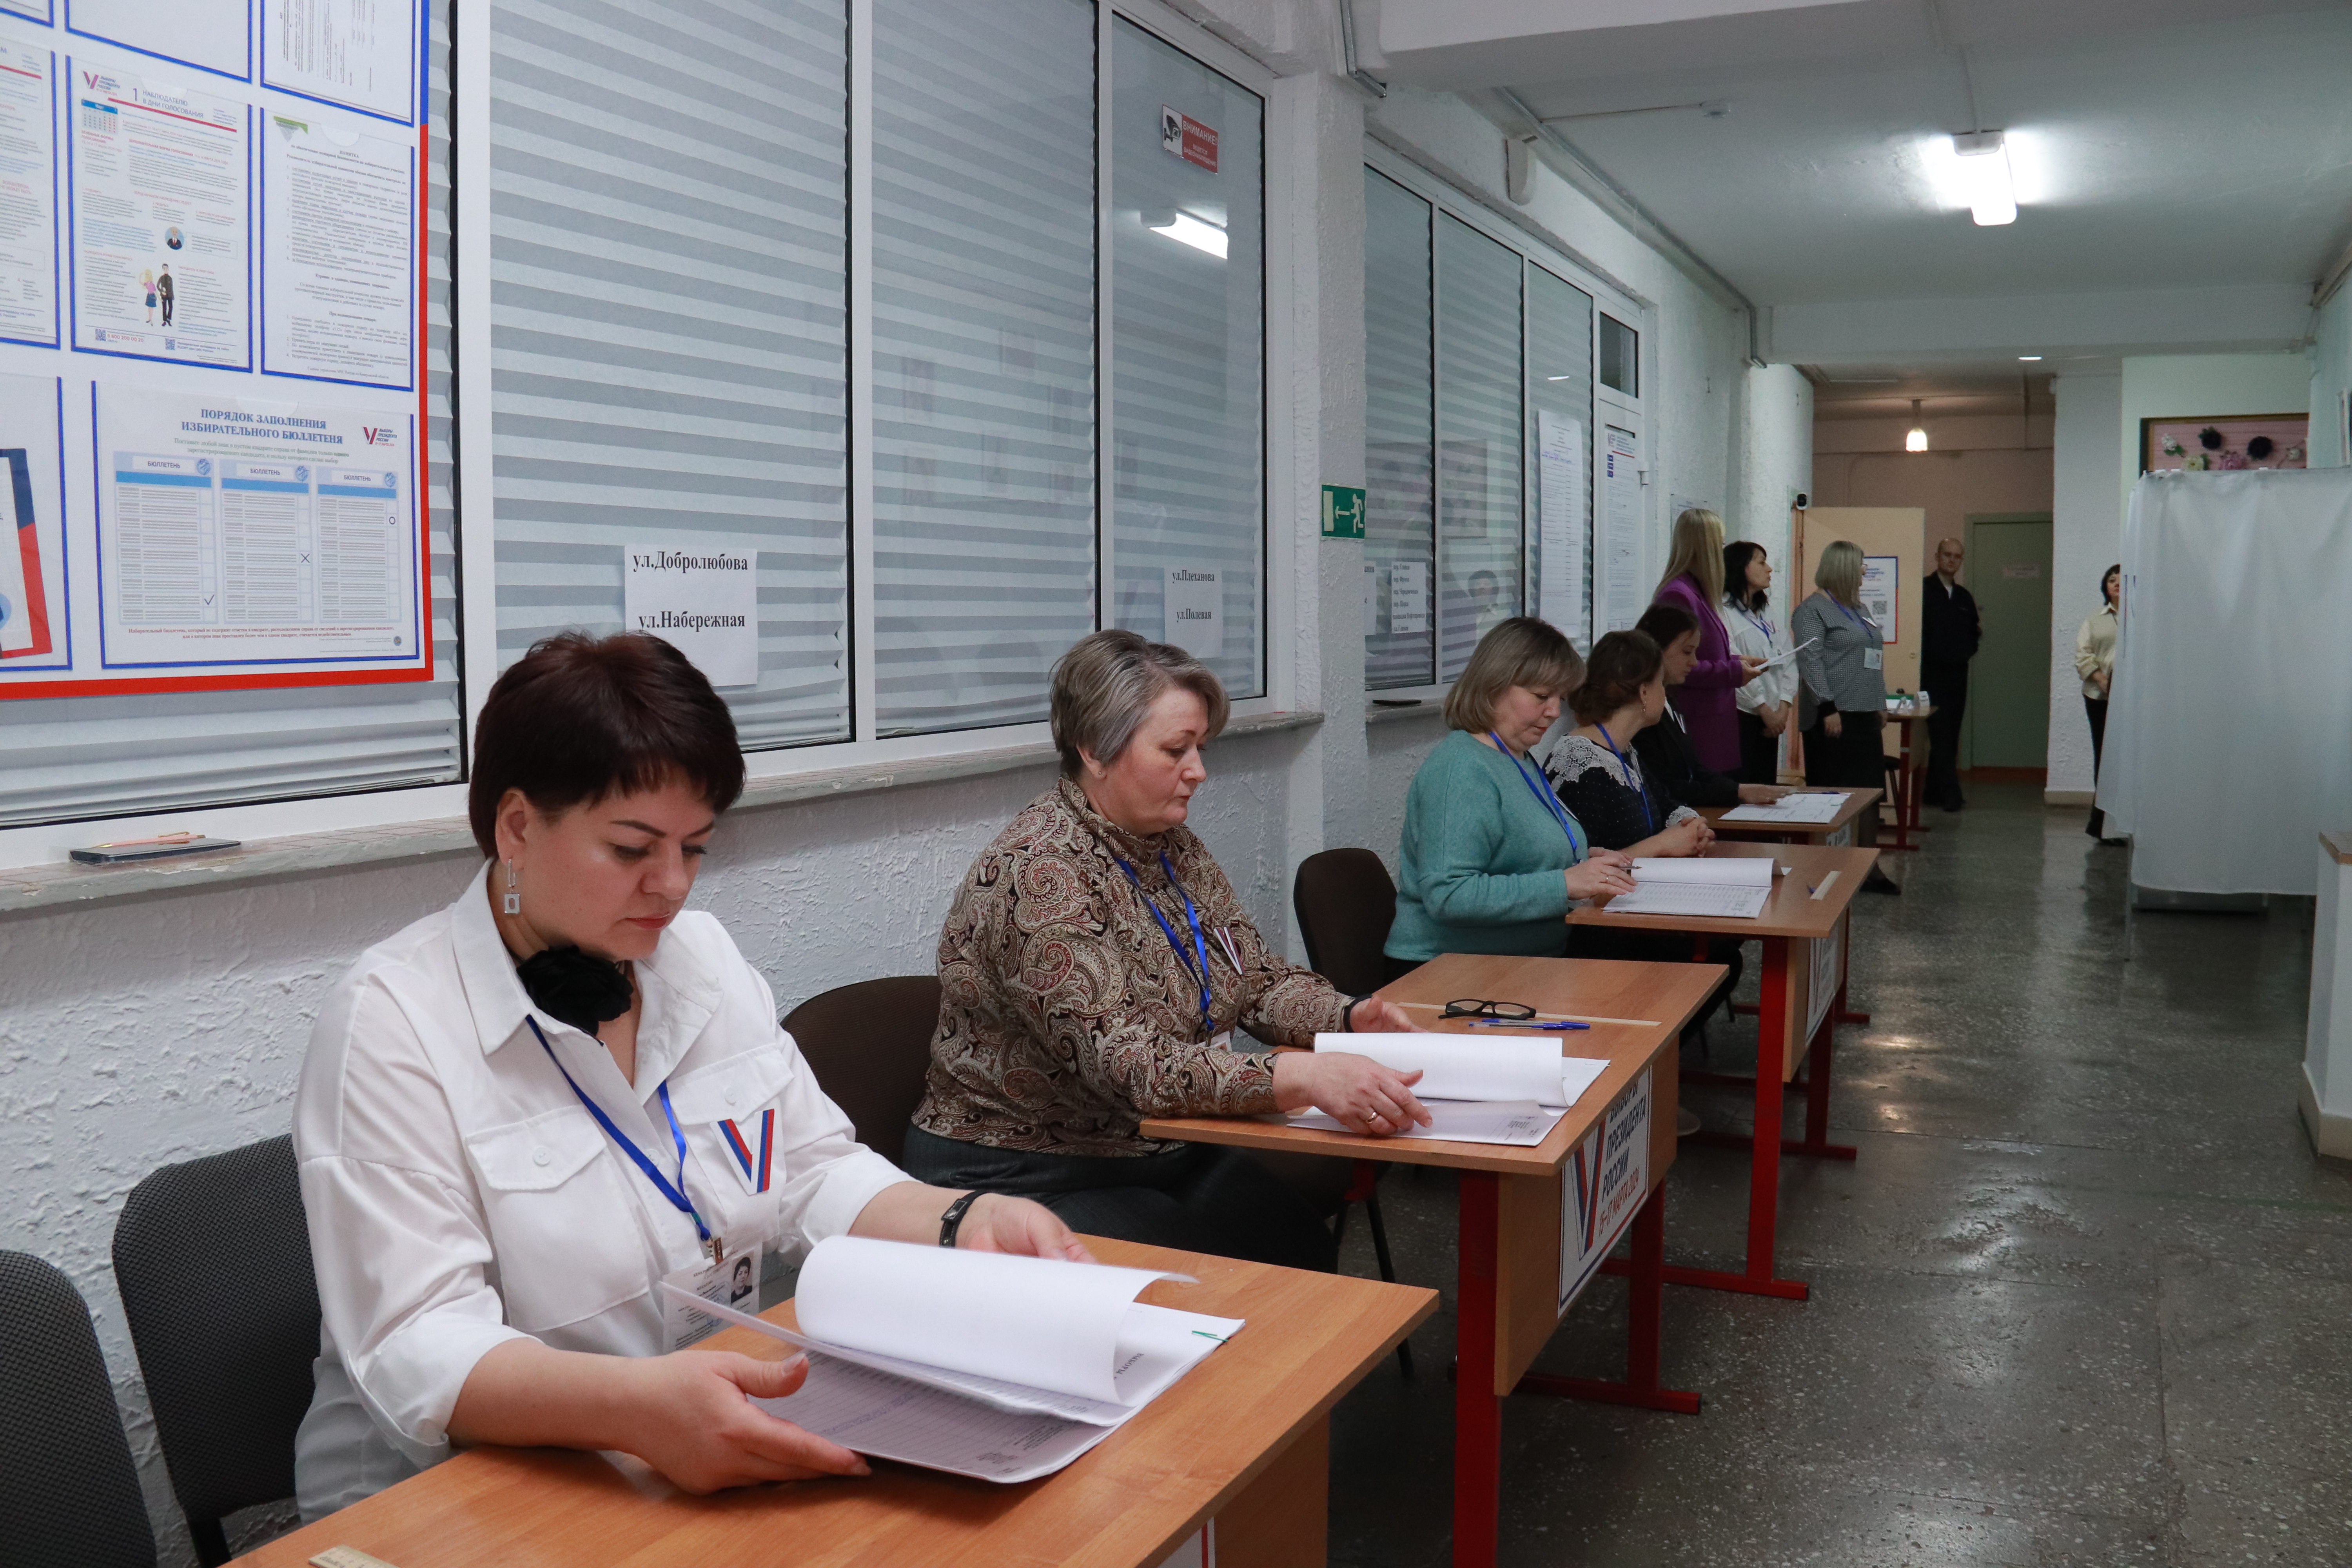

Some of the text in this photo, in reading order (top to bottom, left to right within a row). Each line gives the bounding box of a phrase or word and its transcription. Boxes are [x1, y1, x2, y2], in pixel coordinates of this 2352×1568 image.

[132, 88, 137, 102] 1
[143, 90, 188, 107] НАБЛЮДАТЕЛЮ
[147, 100, 161, 108] ДНИ
[162, 103, 204, 118] ГОЛОСОВАНИЯ
[1183, 120, 1217, 146] ВНИМАНИЕ!
[201, 409, 326, 429] ПОРЯДОК ЗАПОЛНЕНИЯ
[181, 421, 343, 444] ИЗБИРАТЕЛЬНОГО БЮЛЛЕТЕНЯ
[633, 551, 748, 573] ул.Добролюбова
[1172, 570, 1214, 584] ул.Плеханова
[638, 611, 745, 632] ул.Набережная
[1176, 608, 1211, 622] ул.Полевая
[1606, 1094, 1646, 1163] ПРЕЗИДЕНТА
[1602, 1146, 1629, 1203] РОССИИ
[1116, 1353, 1144, 1374] ВЫБОРЫ
